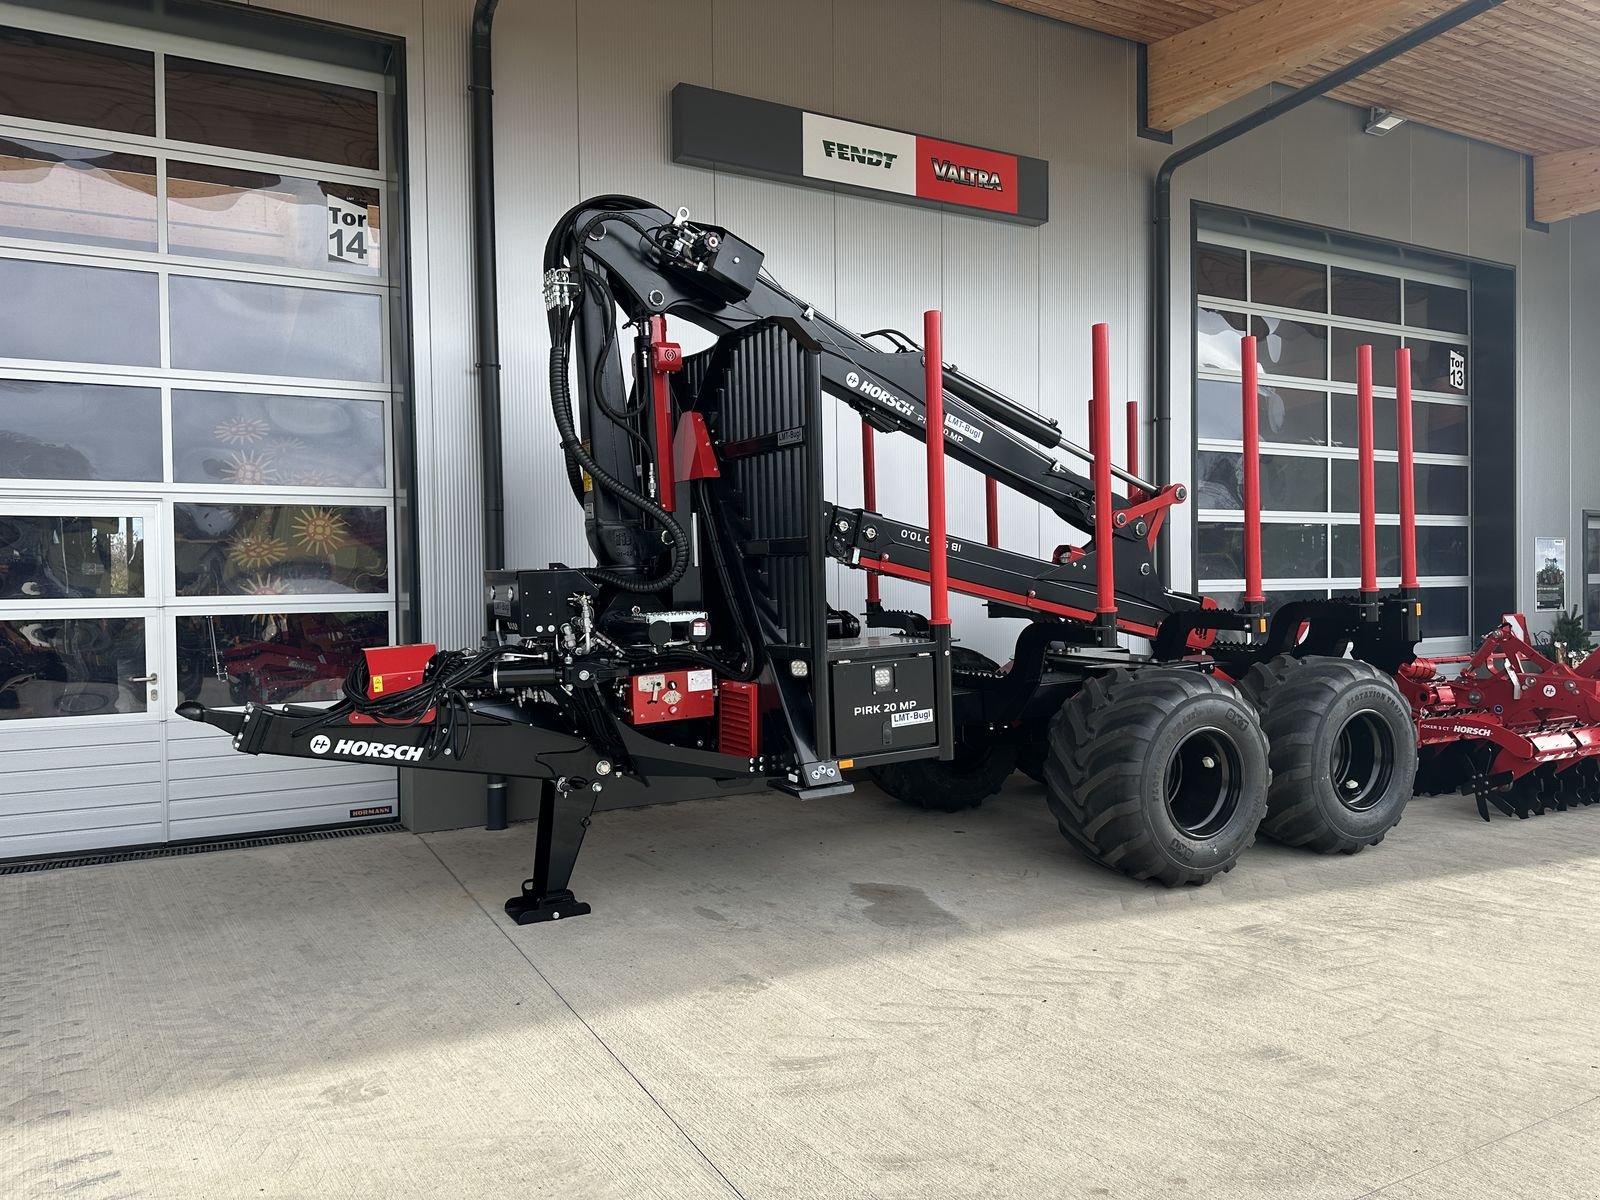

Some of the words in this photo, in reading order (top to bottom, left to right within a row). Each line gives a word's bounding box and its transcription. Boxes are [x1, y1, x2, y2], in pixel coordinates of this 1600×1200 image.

[822, 139, 898, 169] FENDT
[931, 157, 1003, 192] VALTRA
[328, 206, 367, 227] Tor
[329, 228, 368, 259] 14
[1450, 357, 1463, 369] Tor
[1450, 369, 1464, 387] 13
[860, 381, 914, 416] HORSCH
[950, 432, 964, 442] MP
[946, 414, 981, 439] LMT-Bugl
[854, 704, 880, 716] PIRK
[884, 703, 896, 712] 20
[900, 700, 916, 710] MP
[894, 710, 930, 722] LMT-Bugl
[1225, 707, 1250, 733] BKT
[1453, 725, 1491, 736] HORSCH
[334, 740, 424, 761] HORSCH
